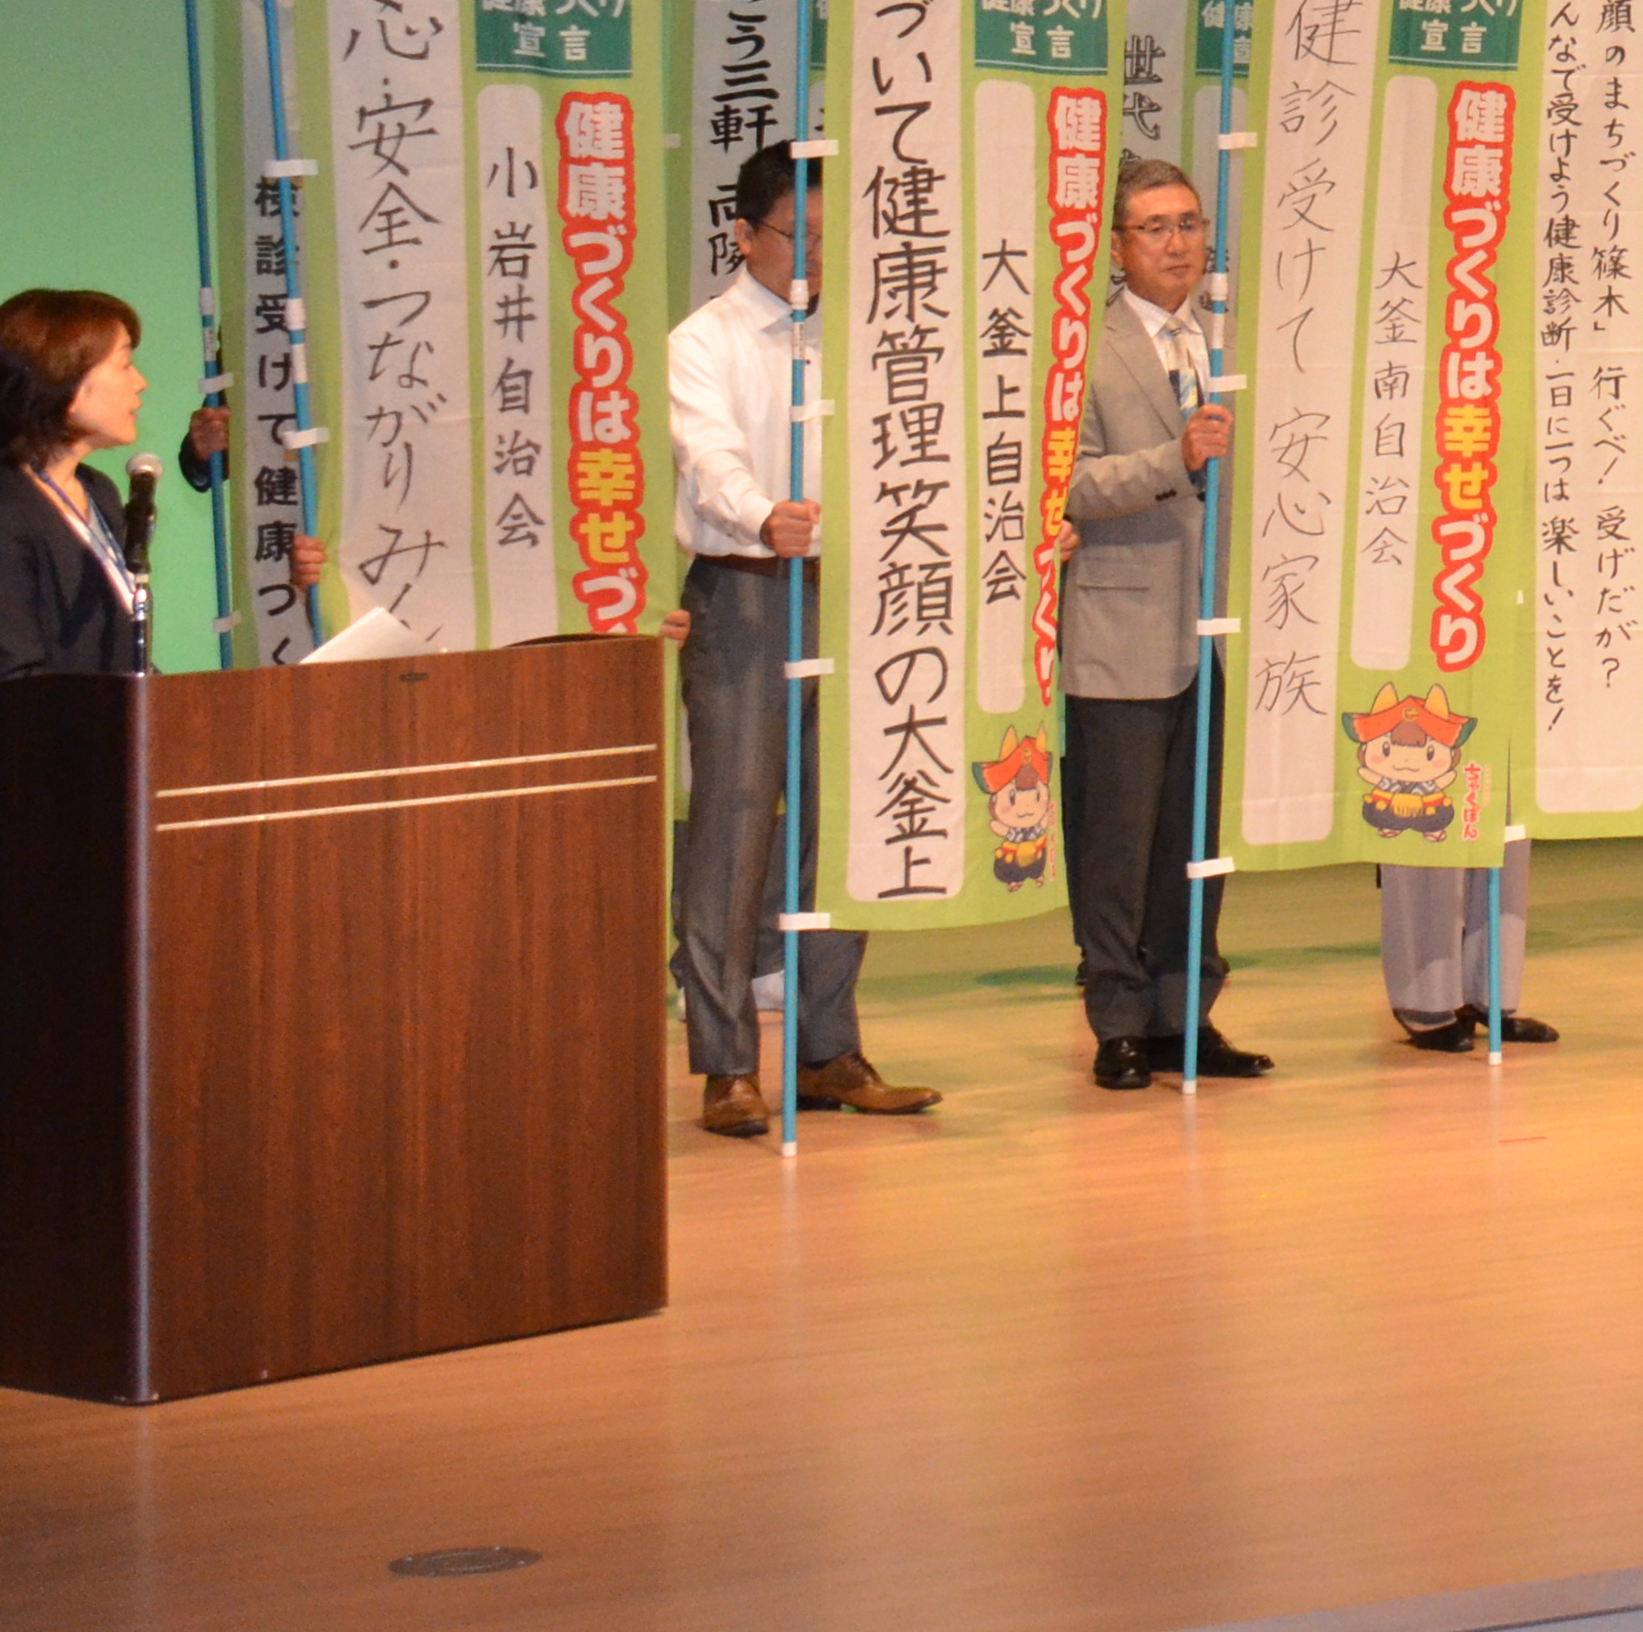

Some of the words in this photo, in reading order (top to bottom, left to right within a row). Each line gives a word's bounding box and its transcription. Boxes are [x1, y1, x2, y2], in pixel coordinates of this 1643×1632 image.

[514, 21, 591, 62] 宣言
[1010, 23, 1073, 59] 宣言
[1422, 20, 1486, 53] 宣言
[487, 148, 544, 550] 小岩井自治会
[980, 239, 1032, 606] 大釜上自治会
[1363, 251, 1423, 566] 大釜南自治会
[1438, 89, 1506, 665] 健康づくりは幸せづくり
